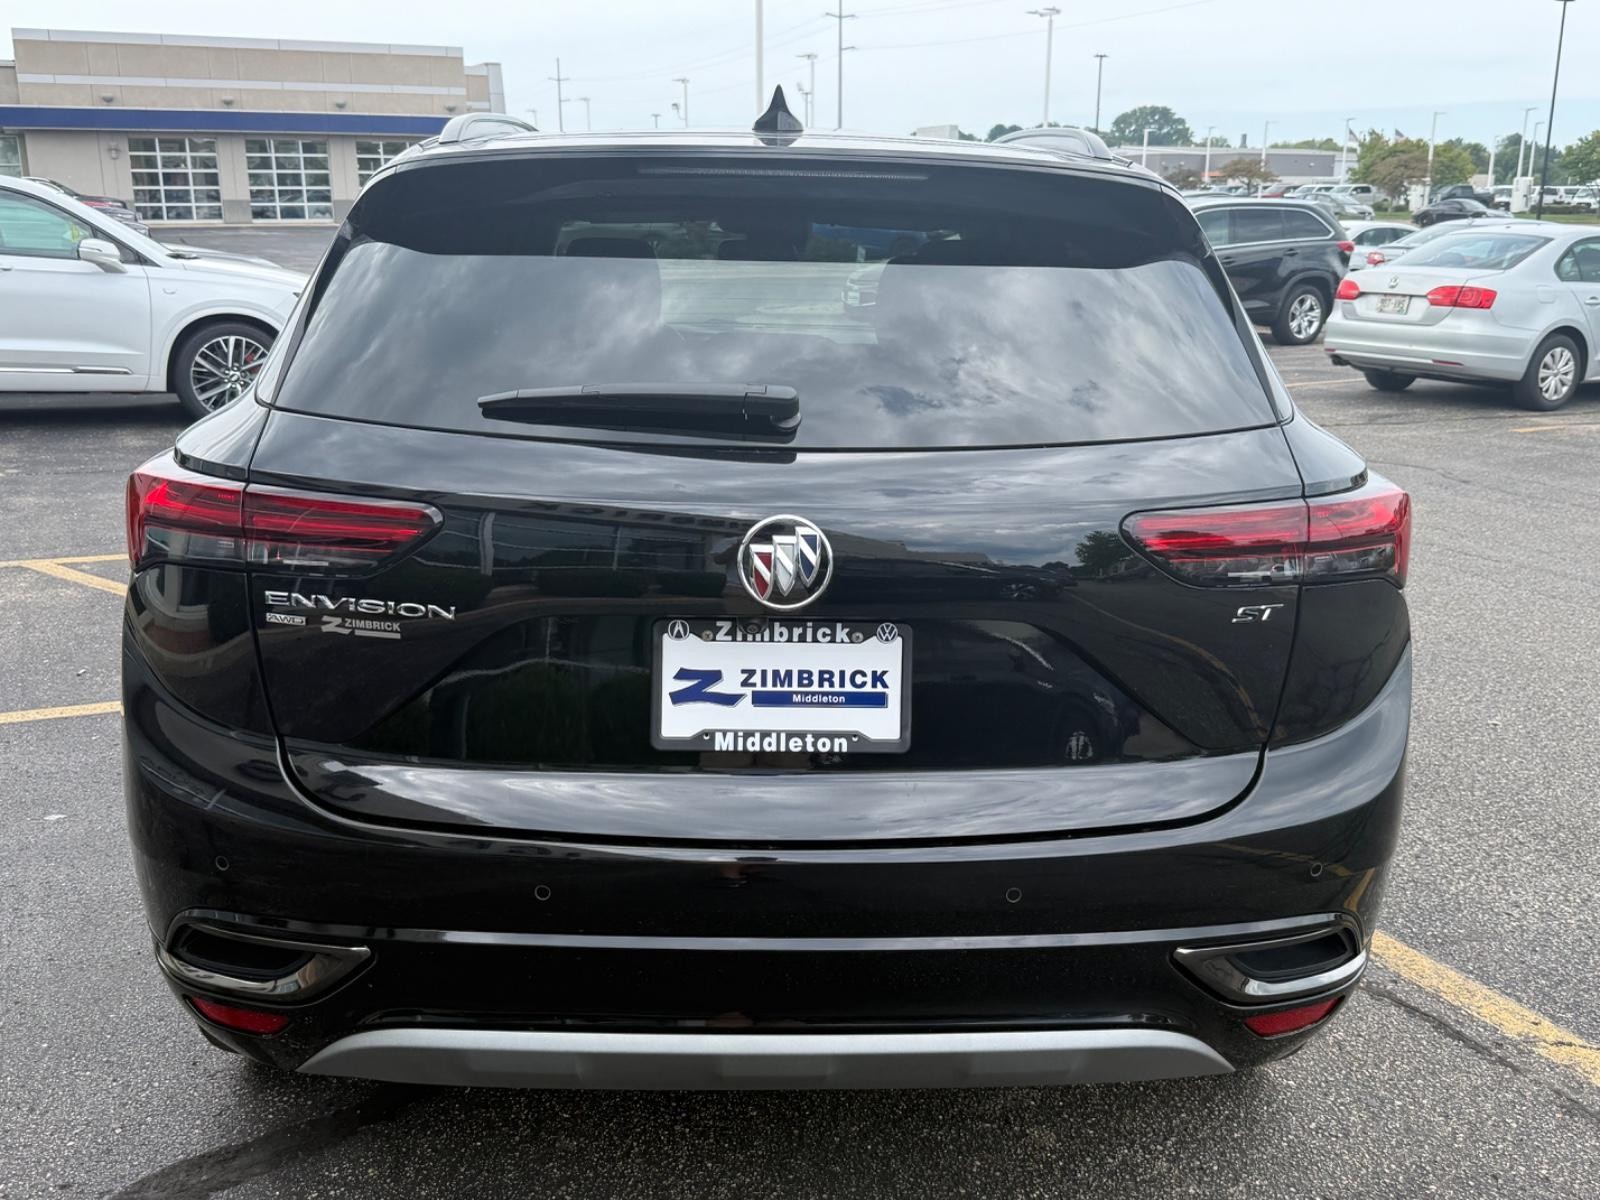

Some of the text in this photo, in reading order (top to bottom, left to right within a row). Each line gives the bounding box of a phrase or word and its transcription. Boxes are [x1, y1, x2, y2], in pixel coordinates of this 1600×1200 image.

[264, 590, 456, 621] ENVISION
[1231, 603, 1284, 624] ST
[266, 612, 306, 626] AWD
[344, 618, 401, 632] ZIMBRICK
[740, 669, 890, 689] ZIMBRICK
[792, 694, 846, 704] Middleton
[714, 731, 848, 753] Middleton
